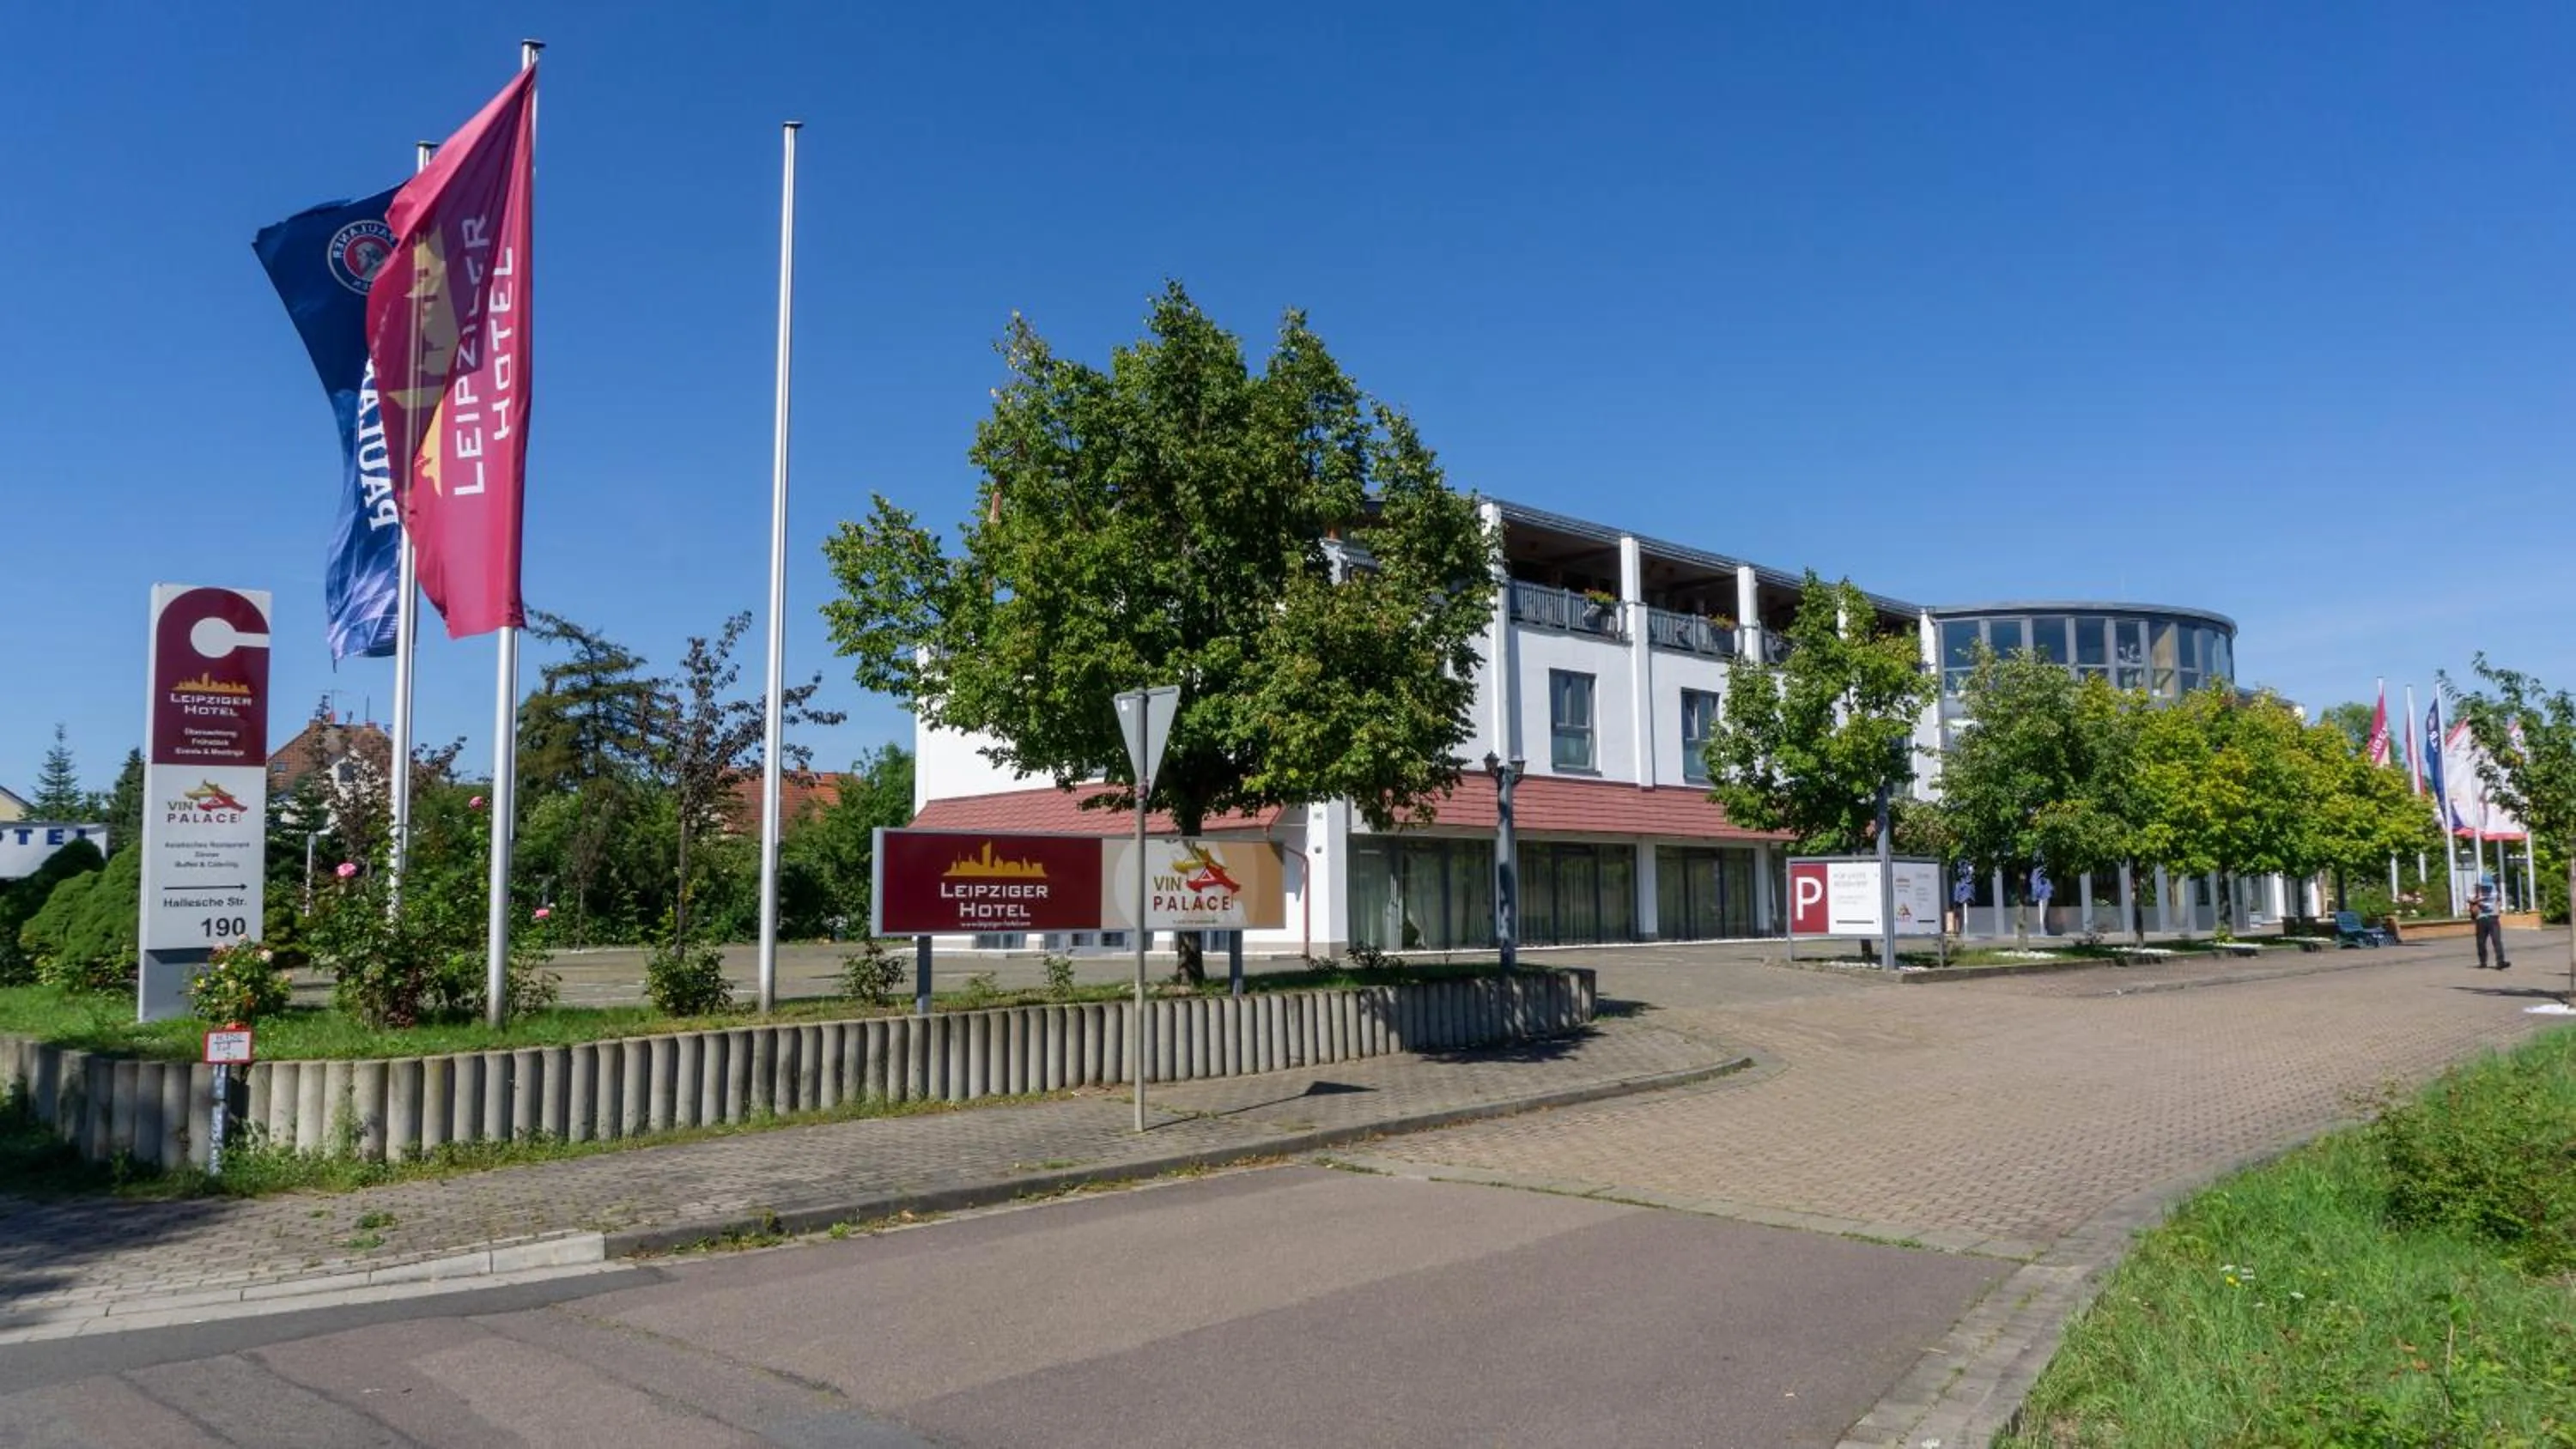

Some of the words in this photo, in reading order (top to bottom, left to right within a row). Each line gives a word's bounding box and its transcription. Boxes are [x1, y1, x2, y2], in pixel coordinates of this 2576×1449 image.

[491, 246, 513, 440] HOTEL
[170, 692, 252, 706] LEIPZIGER
[185, 705, 239, 717] HOTEL
[167, 800, 194, 811] VIN
[167, 812, 240, 823] PALACE
[0, 828, 86, 846] TE
[940, 882, 1048, 898] LEIPZIGER
[1153, 876, 1182, 892] VIN
[163, 897, 224, 907] Hallesche
[227, 896, 247, 907] Str.
[1153, 894, 1231, 911] PALACE
[1795, 876, 1823, 921] P
[959, 901, 1031, 918] HOTEL
[201, 916, 246, 937] 190
